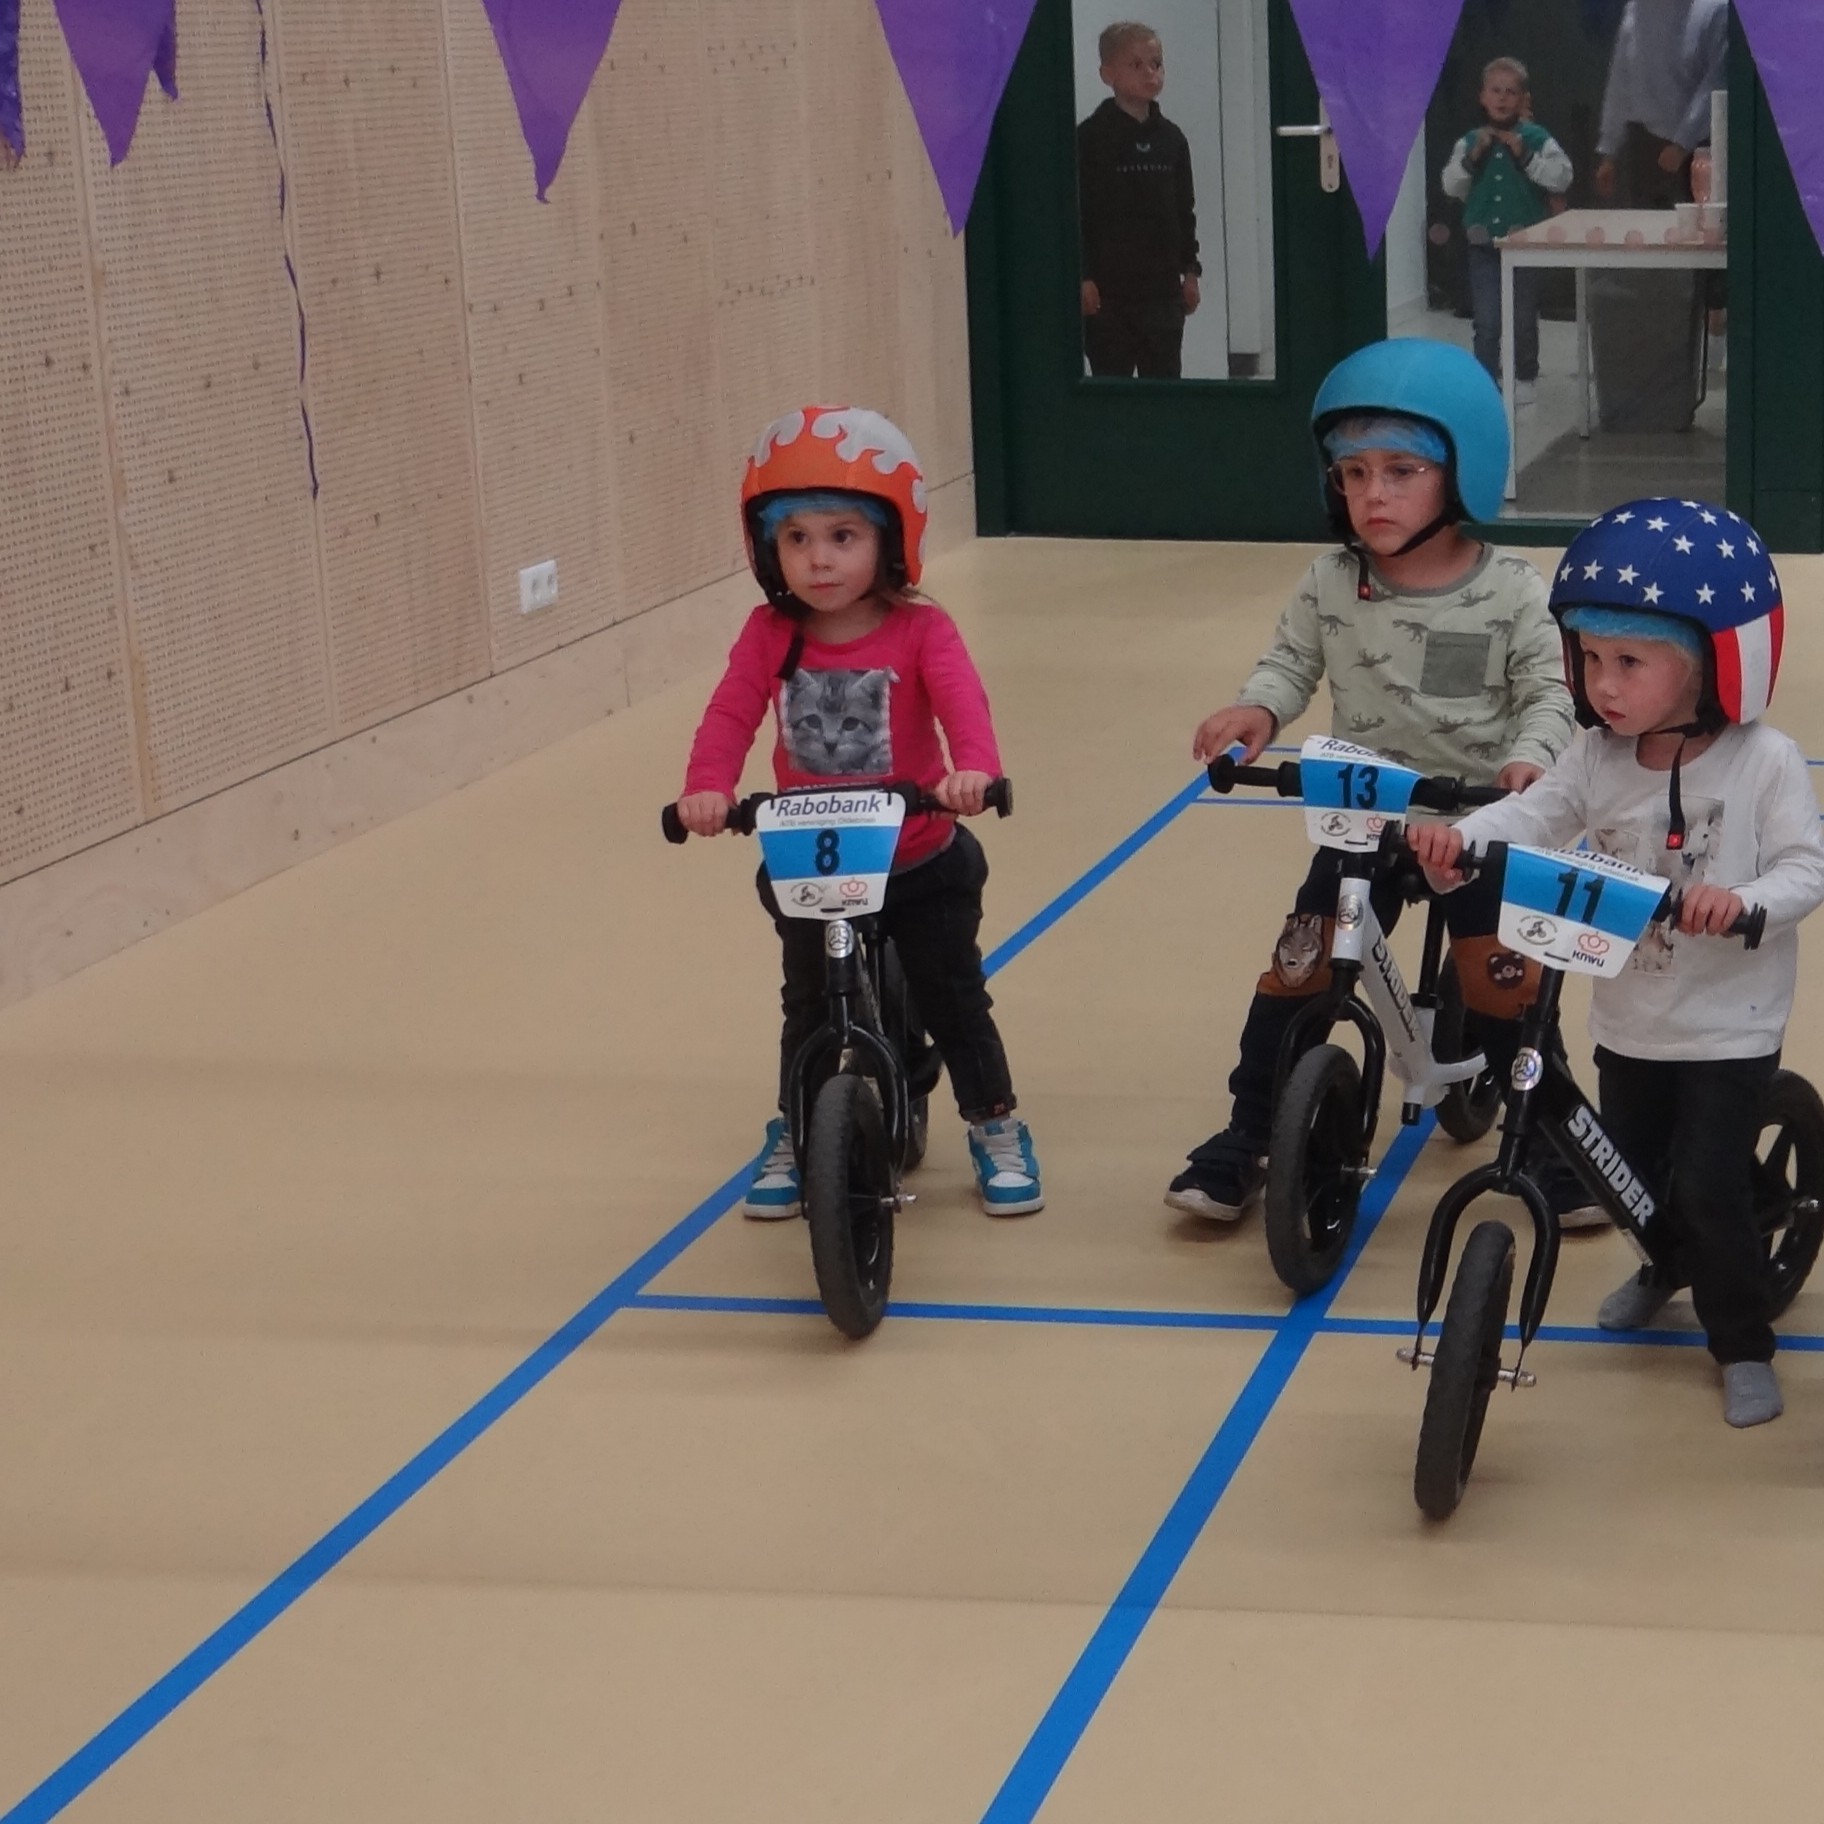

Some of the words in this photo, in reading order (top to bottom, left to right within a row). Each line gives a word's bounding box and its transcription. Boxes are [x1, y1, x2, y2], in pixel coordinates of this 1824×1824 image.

[776, 795, 881, 817] Rabobank
[1337, 764, 1380, 809] 13
[815, 829, 840, 876] 8
[1557, 867, 1605, 925] 11
[1567, 1104, 1656, 1228] STRIDER
